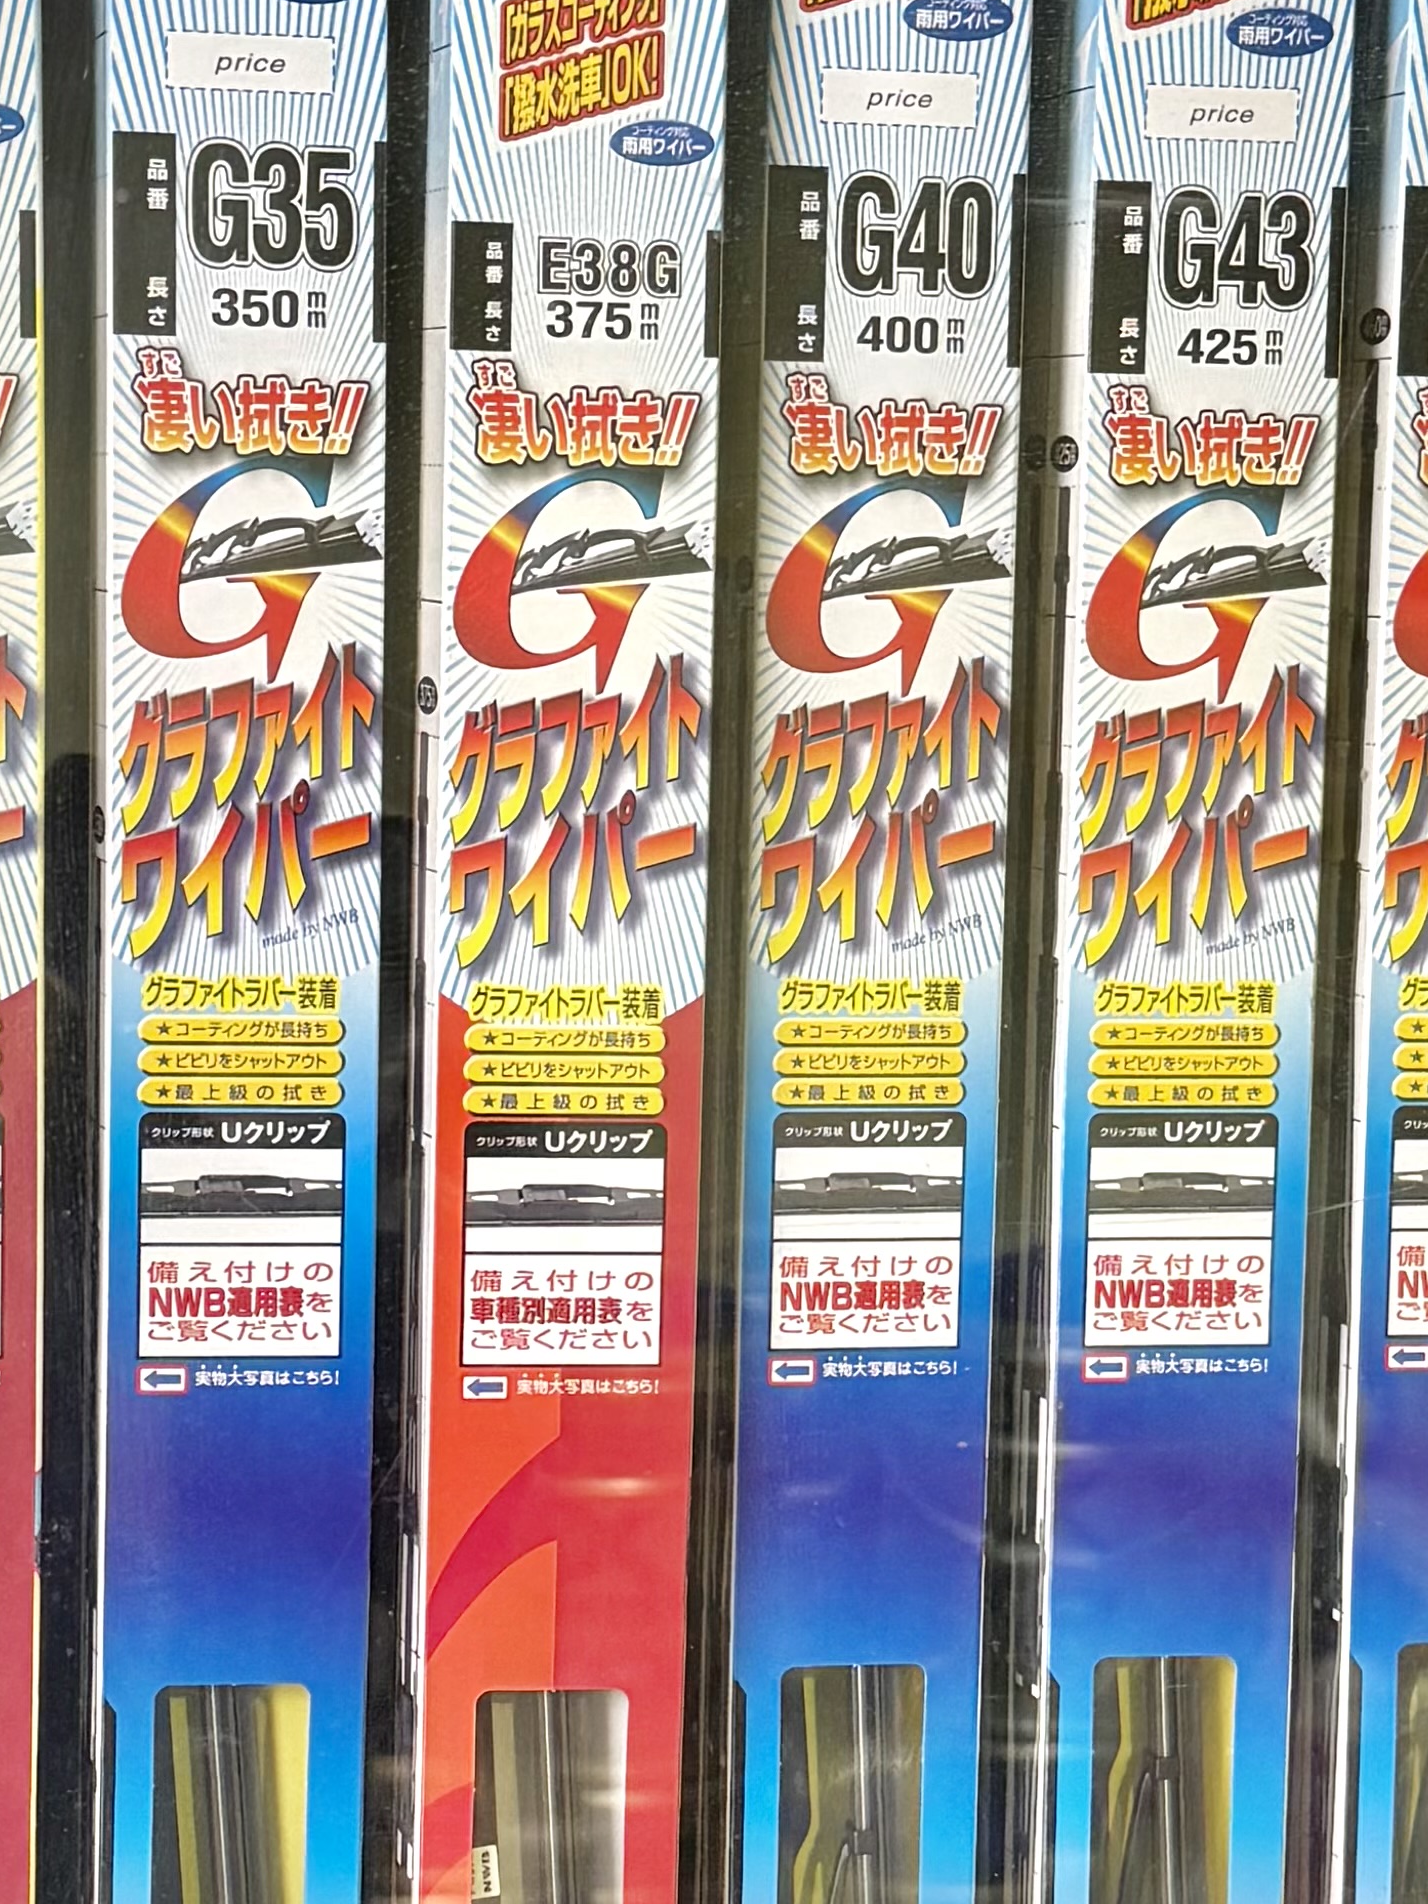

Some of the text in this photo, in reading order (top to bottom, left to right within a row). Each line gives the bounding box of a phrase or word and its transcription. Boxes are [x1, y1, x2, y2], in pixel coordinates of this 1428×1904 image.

[915, 10, 1005, 31] 雨用ワイパー
[1238, 25, 1325, 46] 雨用ワイパー
[214, 53, 287, 74] price
[866, 87, 934, 111] price
[1189, 104, 1255, 125] price
[622, 137, 707, 156] 雨用ワイパー
[188, 137, 357, 274] G35
[837, 169, 997, 300] G40
[1160, 184, 1315, 312] G43
[538, 236, 682, 297] E38G
[119, 642, 375, 836] グラファイト
[450, 654, 702, 847] グラファイト
[762, 656, 1000, 845] グラファイト
[1080, 665, 1316, 848] グラファイト
[121, 780, 371, 958] ワイパー
[450, 791, 697, 970] ワイパー
[760, 789, 995, 963] ワイパー
[1080, 795, 1309, 967] ワイパー
[262, 928, 299, 948] made
[323, 909, 359, 932] NWB
[143, 978, 339, 1012] グラファイトラバー装着
[472, 987, 661, 1021] グラファイトラバー装着
[781, 981, 961, 1013] グラファイトラバー装着
[1097, 982, 1276, 1014] グラファイトラバー装着
[175, 1083, 328, 1102] 最上級の拭き
[222, 1120, 330, 1145] Uクリップ
[545, 1129, 653, 1155] Uクリップ
[1164, 1120, 1266, 1144] Uクリップ
[148, 1261, 332, 1284] 備え付けの
[472, 1270, 654, 1292] 備え付けの
[148, 1320, 331, 1343] ご覧ください
[471, 1328, 653, 1351] ご覧ください
